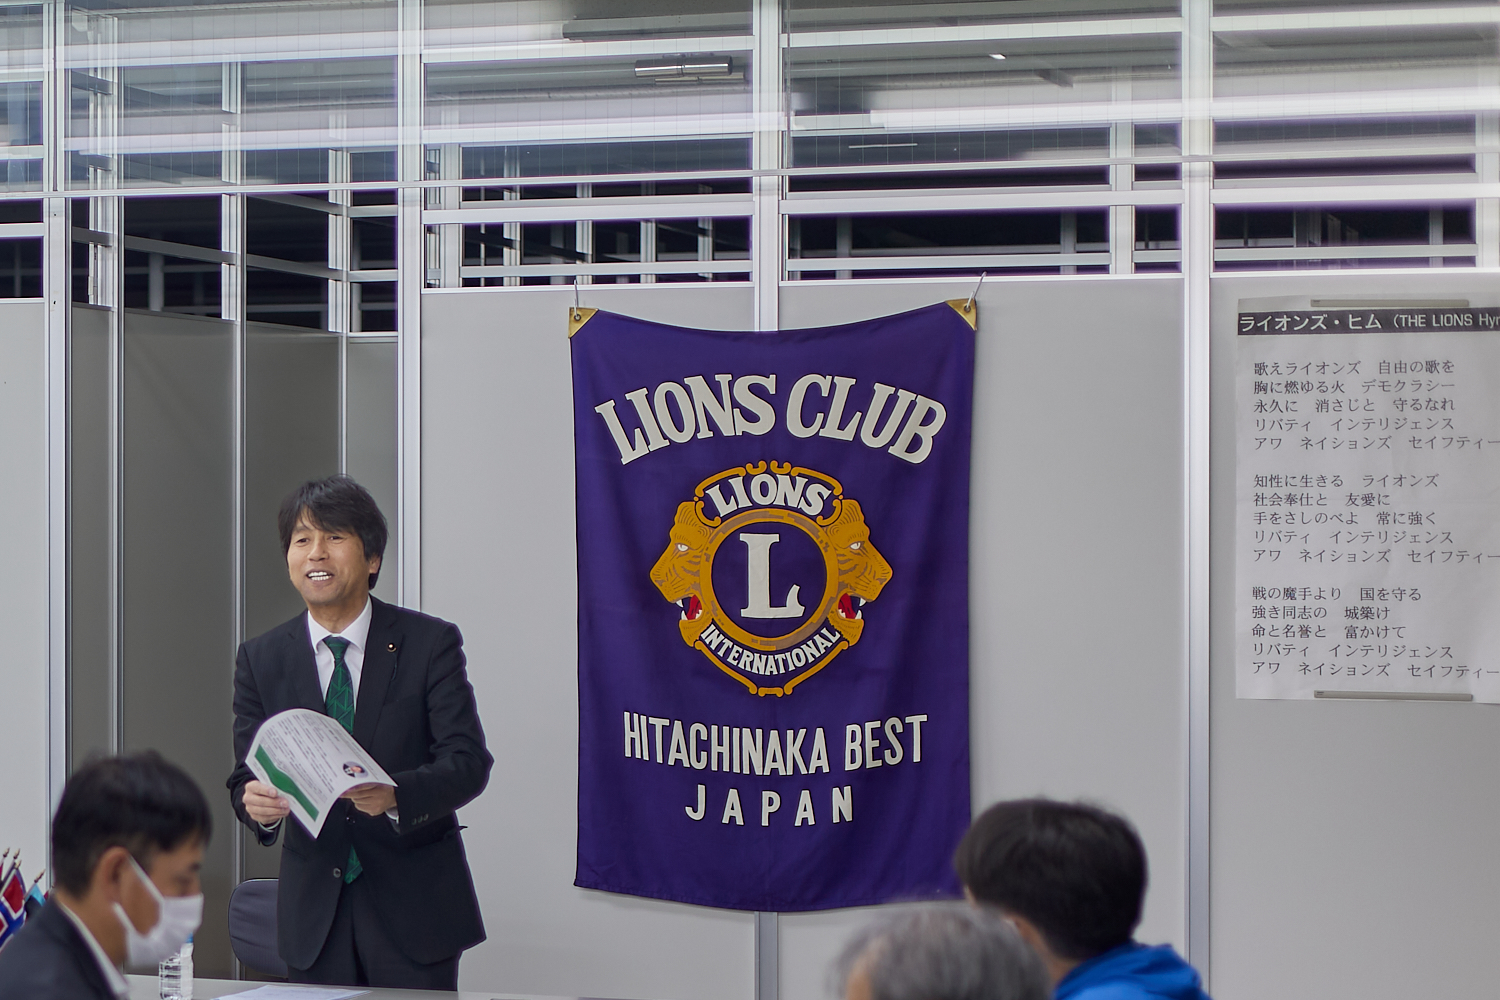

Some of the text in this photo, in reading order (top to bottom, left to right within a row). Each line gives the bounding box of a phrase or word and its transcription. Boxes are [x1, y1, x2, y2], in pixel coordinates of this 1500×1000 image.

[1432, 312, 1473, 327] LIONS
[1253, 359, 1455, 376] 歌えライオンズ 自由の歌を
[1253, 379, 1455, 395] 胸に燃ゆる火 デモクラシー
[1253, 397, 1456, 414] 永久に 消さじと 守るなれ
[594, 373, 947, 465] LIONS CLUB
[1255, 417, 1455, 432] リバティ インテリジェンス
[1254, 436, 1283, 451] アワ
[1300, 435, 1392, 451] ネイションズ
[1253, 473, 1440, 489] 知性に生きる ライオンズ
[705, 473, 832, 518] LIONS
[1253, 492, 1391, 507] 社会奉仕と 友愛に
[1253, 511, 1437, 526] 手をさしのべよ 常に強く
[1255, 530, 1455, 545] リバティ インテリジェンス
[1253, 549, 1282, 563] アワ
[1299, 549, 1392, 564] ネイションズ
[739, 532, 805, 619] L
[1252, 586, 1422, 602] 戦の魔手より 国を守る
[1252, 605, 1391, 621] 強き同志の 城築け
[1252, 624, 1407, 639] 命と名誉と 富かけて
[701, 622, 842, 677] INTERNATIONAL
[1252, 642, 1454, 659] リバティ インテリジェンス
[1252, 661, 1500, 679] アワ ネイションズ セイフティー
[623, 711, 928, 776] HITACHINAKA BEST
[685, 784, 853, 826] JAPAN
